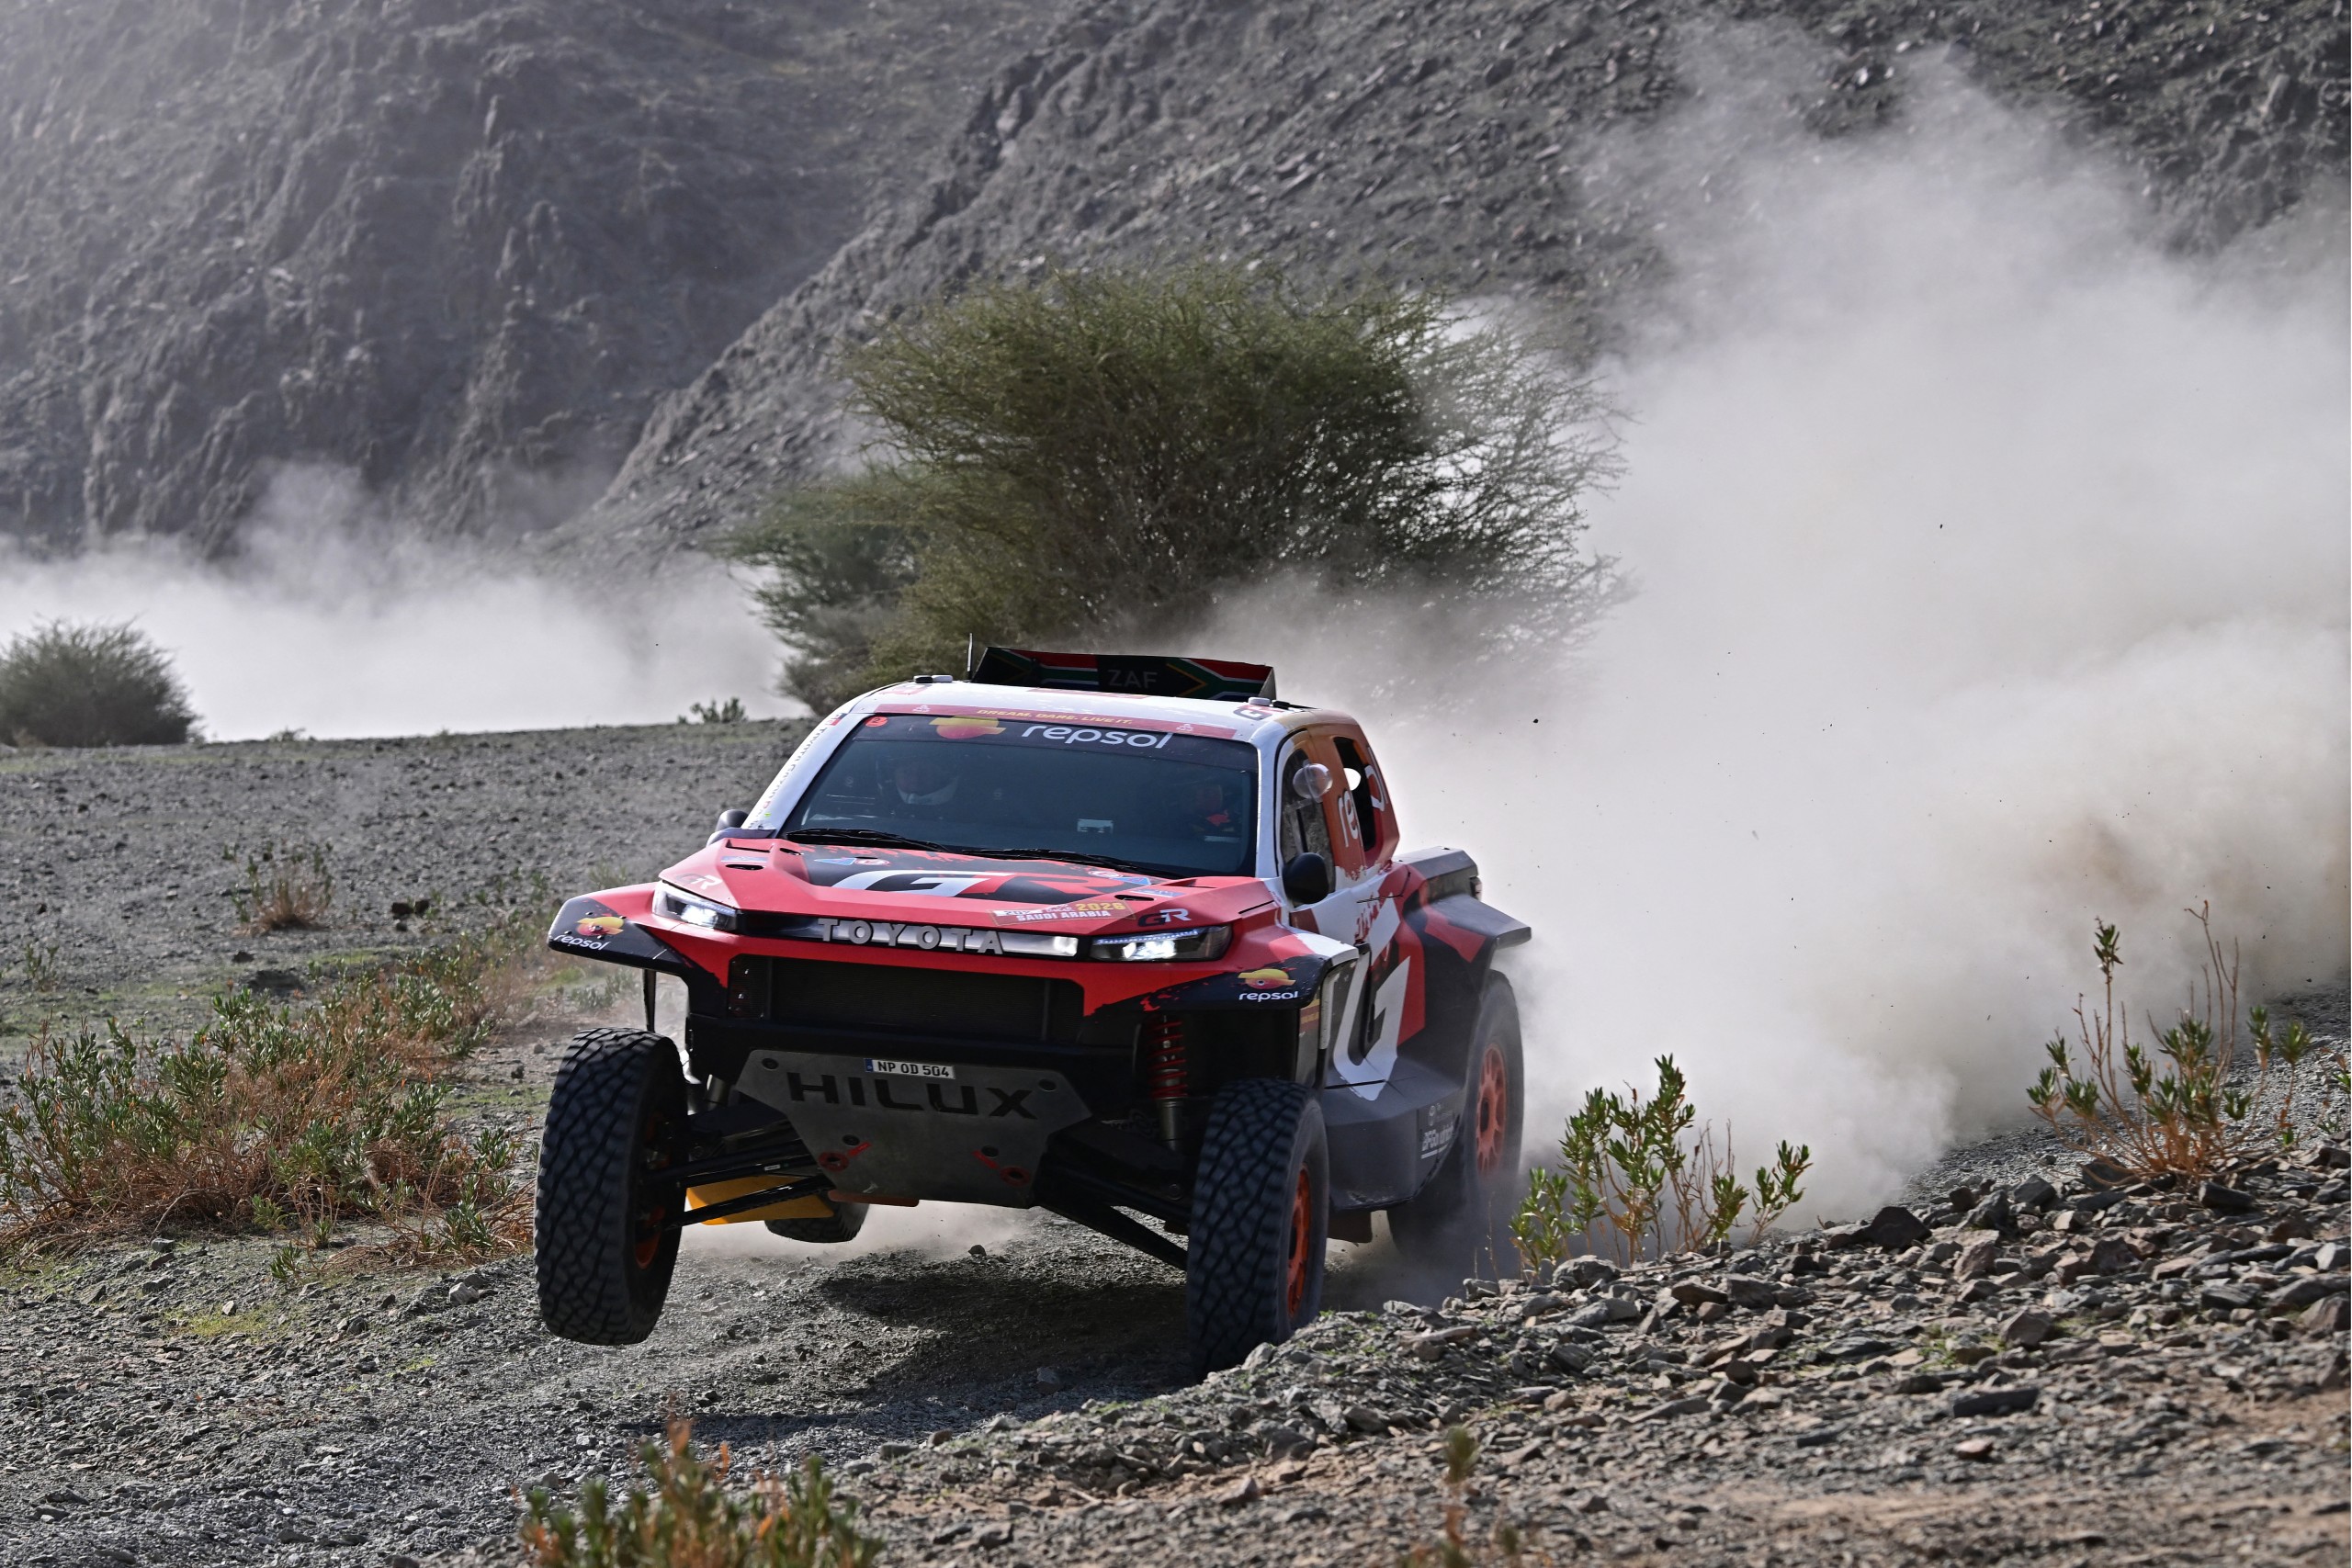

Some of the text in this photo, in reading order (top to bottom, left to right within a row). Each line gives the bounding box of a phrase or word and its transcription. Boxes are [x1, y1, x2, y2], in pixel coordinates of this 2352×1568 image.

[1107, 670, 1158, 689] ZAF
[1022, 725, 1173, 749] repsol
[675, 874, 723, 890] GR
[1076, 902, 1126, 911] 2026
[1016, 912, 1057, 921] SAUDI
[1061, 910, 1111, 919] ARABIA
[1137, 908, 1192, 927] GR
[553, 934, 612, 951] repsol
[818, 918, 1003, 954] TOYOTA
[1238, 990, 1299, 1003] repsol
[877, 1061, 897, 1072] NP
[922, 1065, 950, 1077] 504
[786, 1071, 1038, 1121] HILUX
